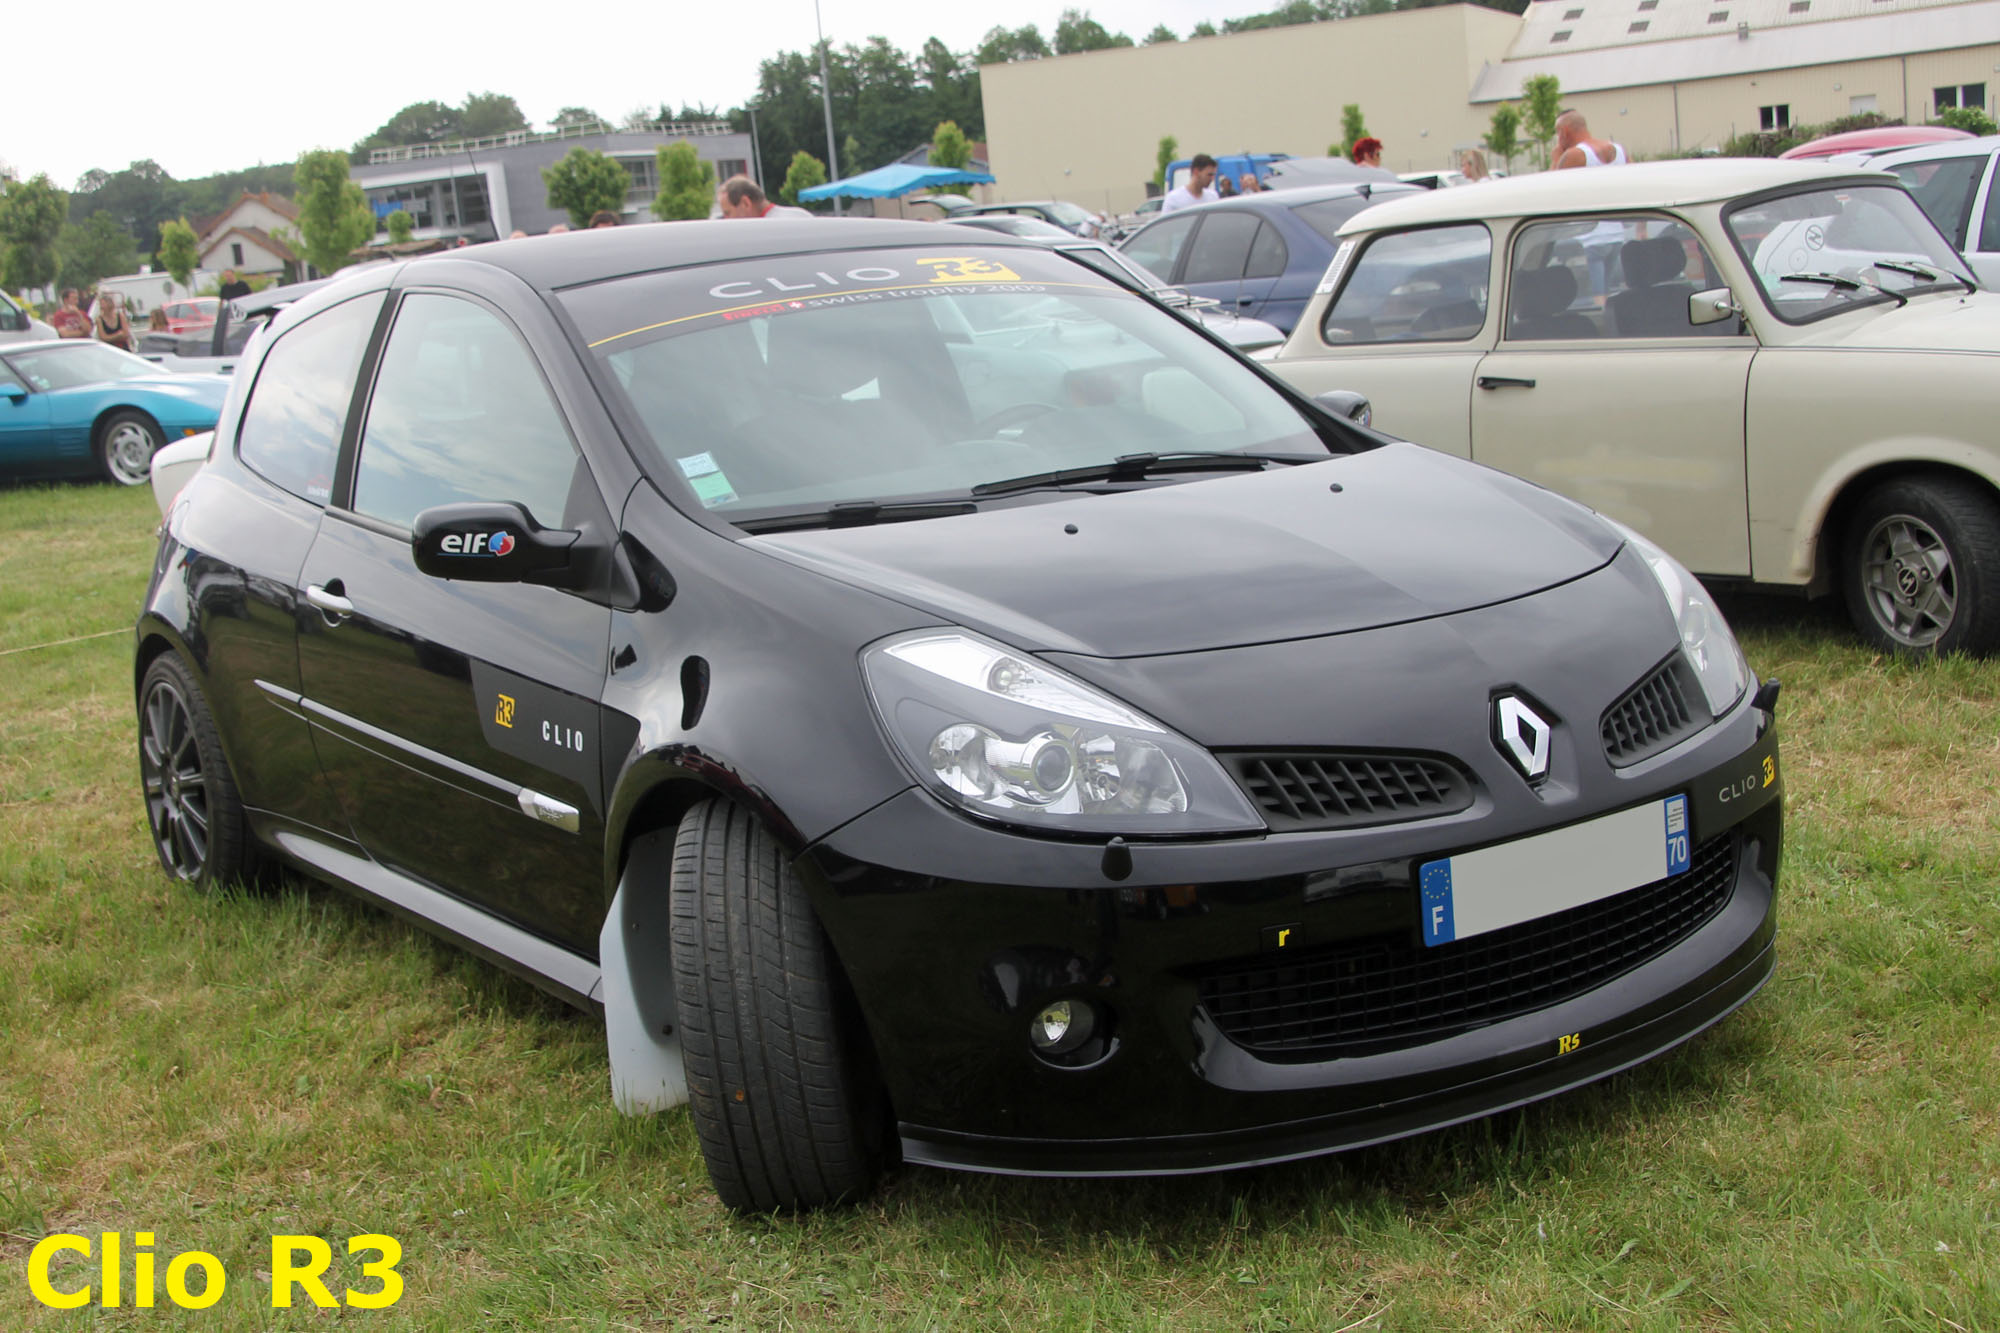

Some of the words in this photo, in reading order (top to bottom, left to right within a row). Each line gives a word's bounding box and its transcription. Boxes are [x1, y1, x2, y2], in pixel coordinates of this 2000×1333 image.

[708, 267, 900, 299] CLIO
[916, 256, 1022, 283] R3
[809, 293, 882, 306] swiss
[887, 285, 977, 298] trophy
[495, 693, 516, 729] R3
[542, 720, 584, 752] CLIO
[1718, 775, 1756, 803] CLIO
[1667, 835, 1687, 866] 70
[1431, 905, 1445, 936] F
[1557, 1032, 1580, 1056] Rs
